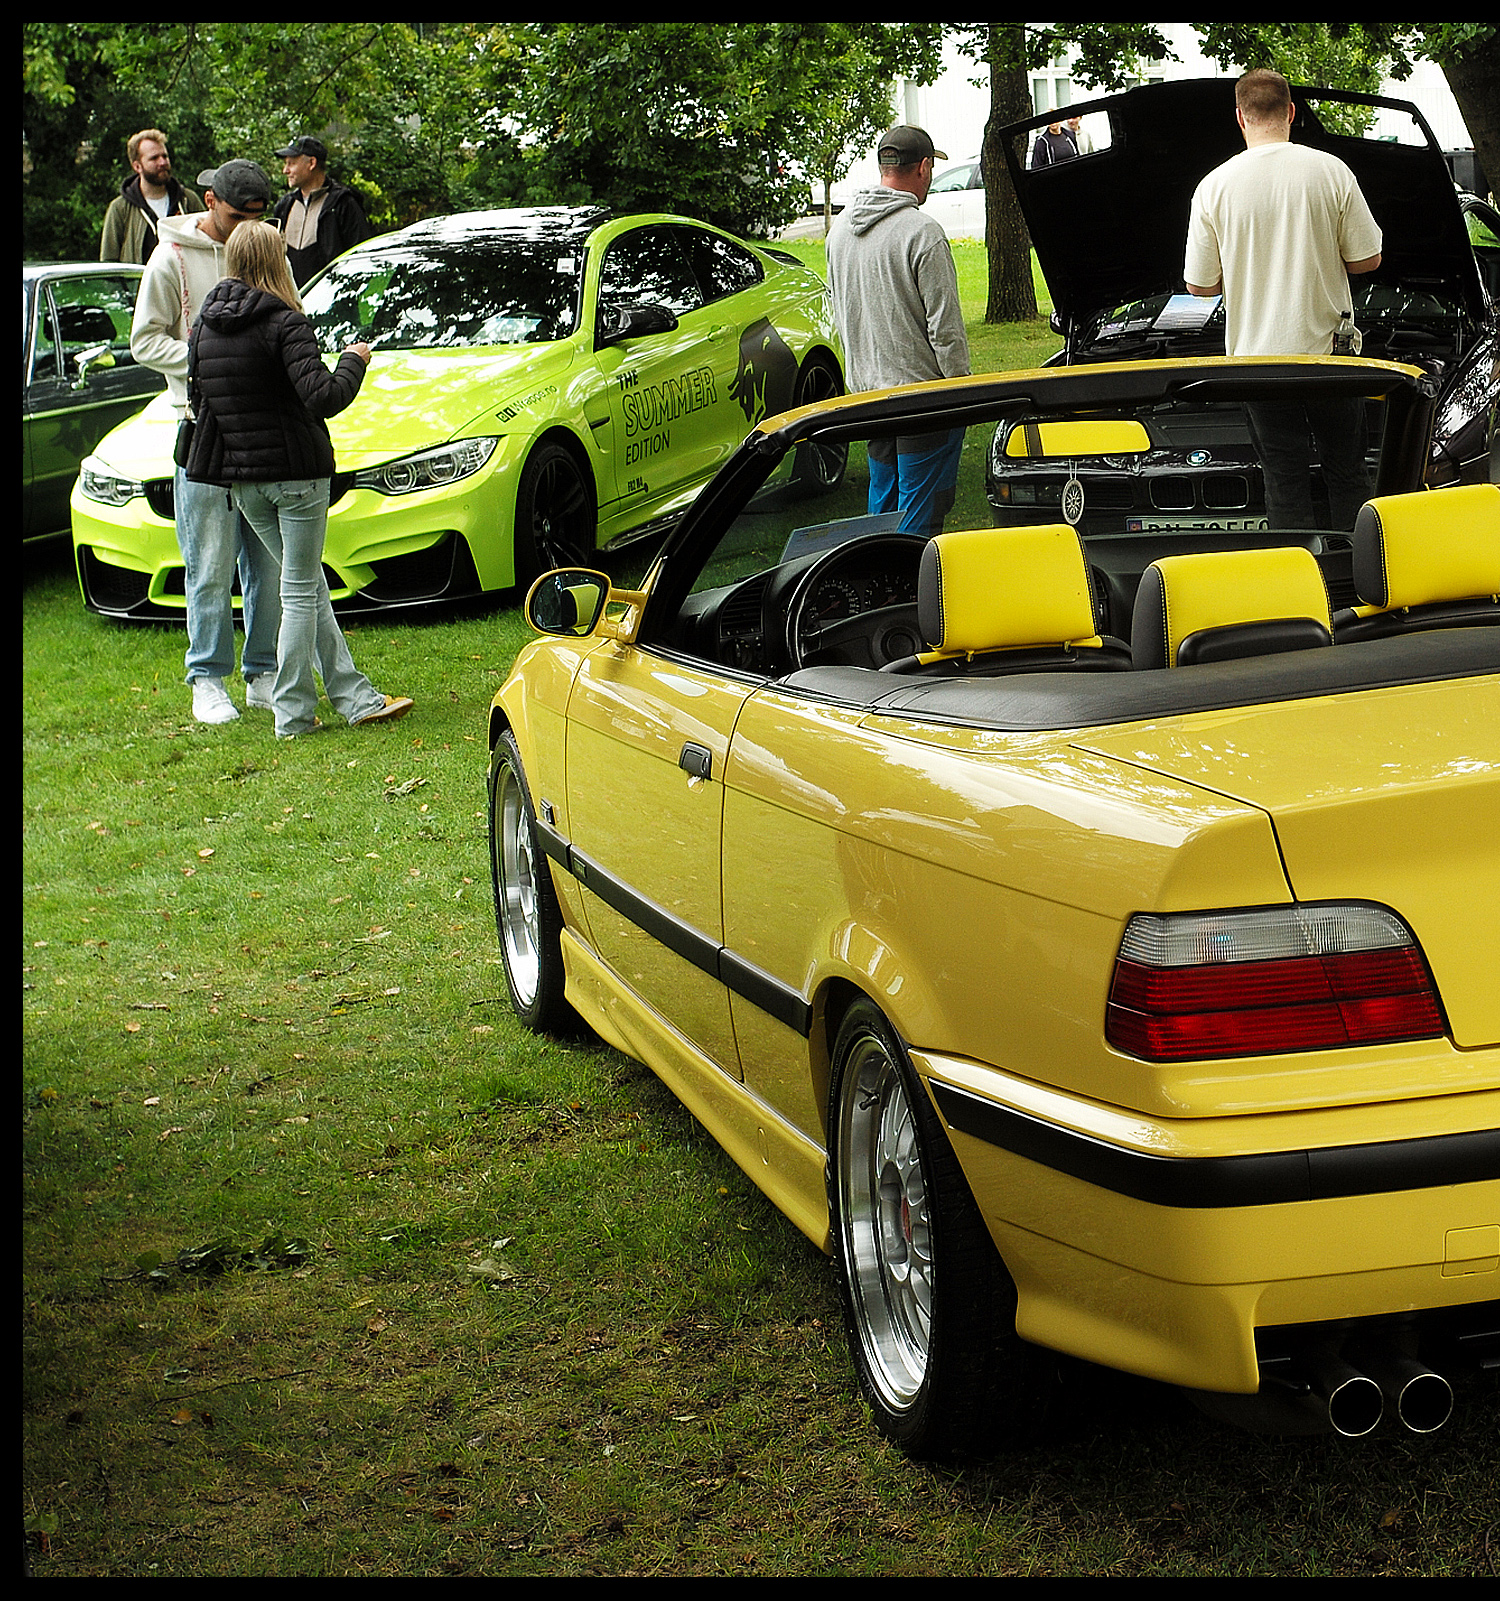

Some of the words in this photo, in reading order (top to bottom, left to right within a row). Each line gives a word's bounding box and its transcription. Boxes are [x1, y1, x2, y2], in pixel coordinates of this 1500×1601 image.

[616, 369, 639, 391] THE
[622, 366, 718, 437] SUMMER
[626, 429, 670, 466] EDITION
